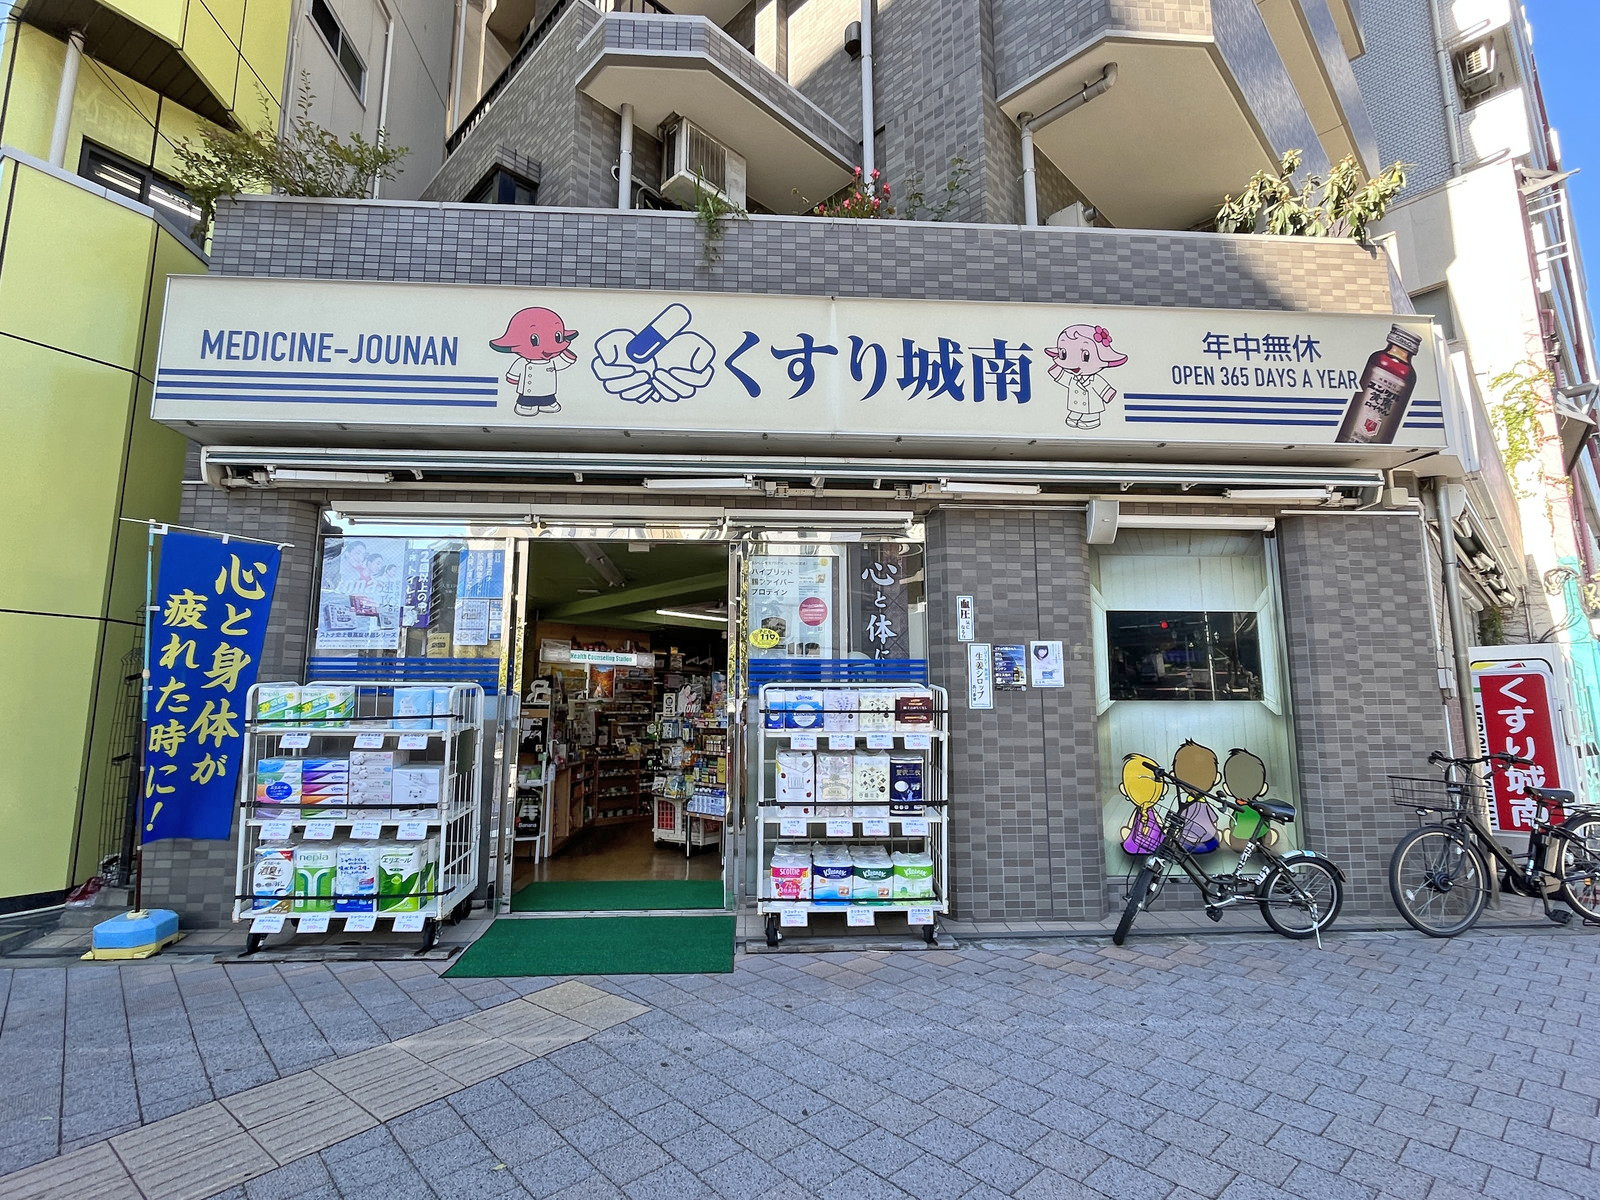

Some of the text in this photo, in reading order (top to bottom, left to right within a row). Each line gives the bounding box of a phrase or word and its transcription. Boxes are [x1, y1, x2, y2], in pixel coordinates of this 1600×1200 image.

[200, 328, 459, 367] MEDICINE-JOUNAN
[1201, 331, 1323, 363] 年中無休
[723, 329, 1034, 404] くすり城南
[1171, 365, 1215, 387] OPEN
[1221, 366, 1249, 388] 365
[1255, 367, 1297, 389] DAYS
[1302, 368, 1314, 389] A
[1317, 368, 1359, 390] YEAR
[751, 568, 793, 576] ハイブリッド
[751, 588, 788, 596] プロテイン
[861, 562, 898, 660] 心と体に
[960, 599, 971, 620] 血圧
[188, 552, 268, 786] 心と身体が
[587, 653, 615, 662] Counseling
[975, 651, 985, 699] 生姜シロップ
[1497, 677, 1550, 829] くすり城南
[779, 868, 801, 876] scottie
[823, 868, 847, 877] Kleenex
[862, 869, 887, 878] Kleenex
[903, 867, 928, 877] Kleenex
